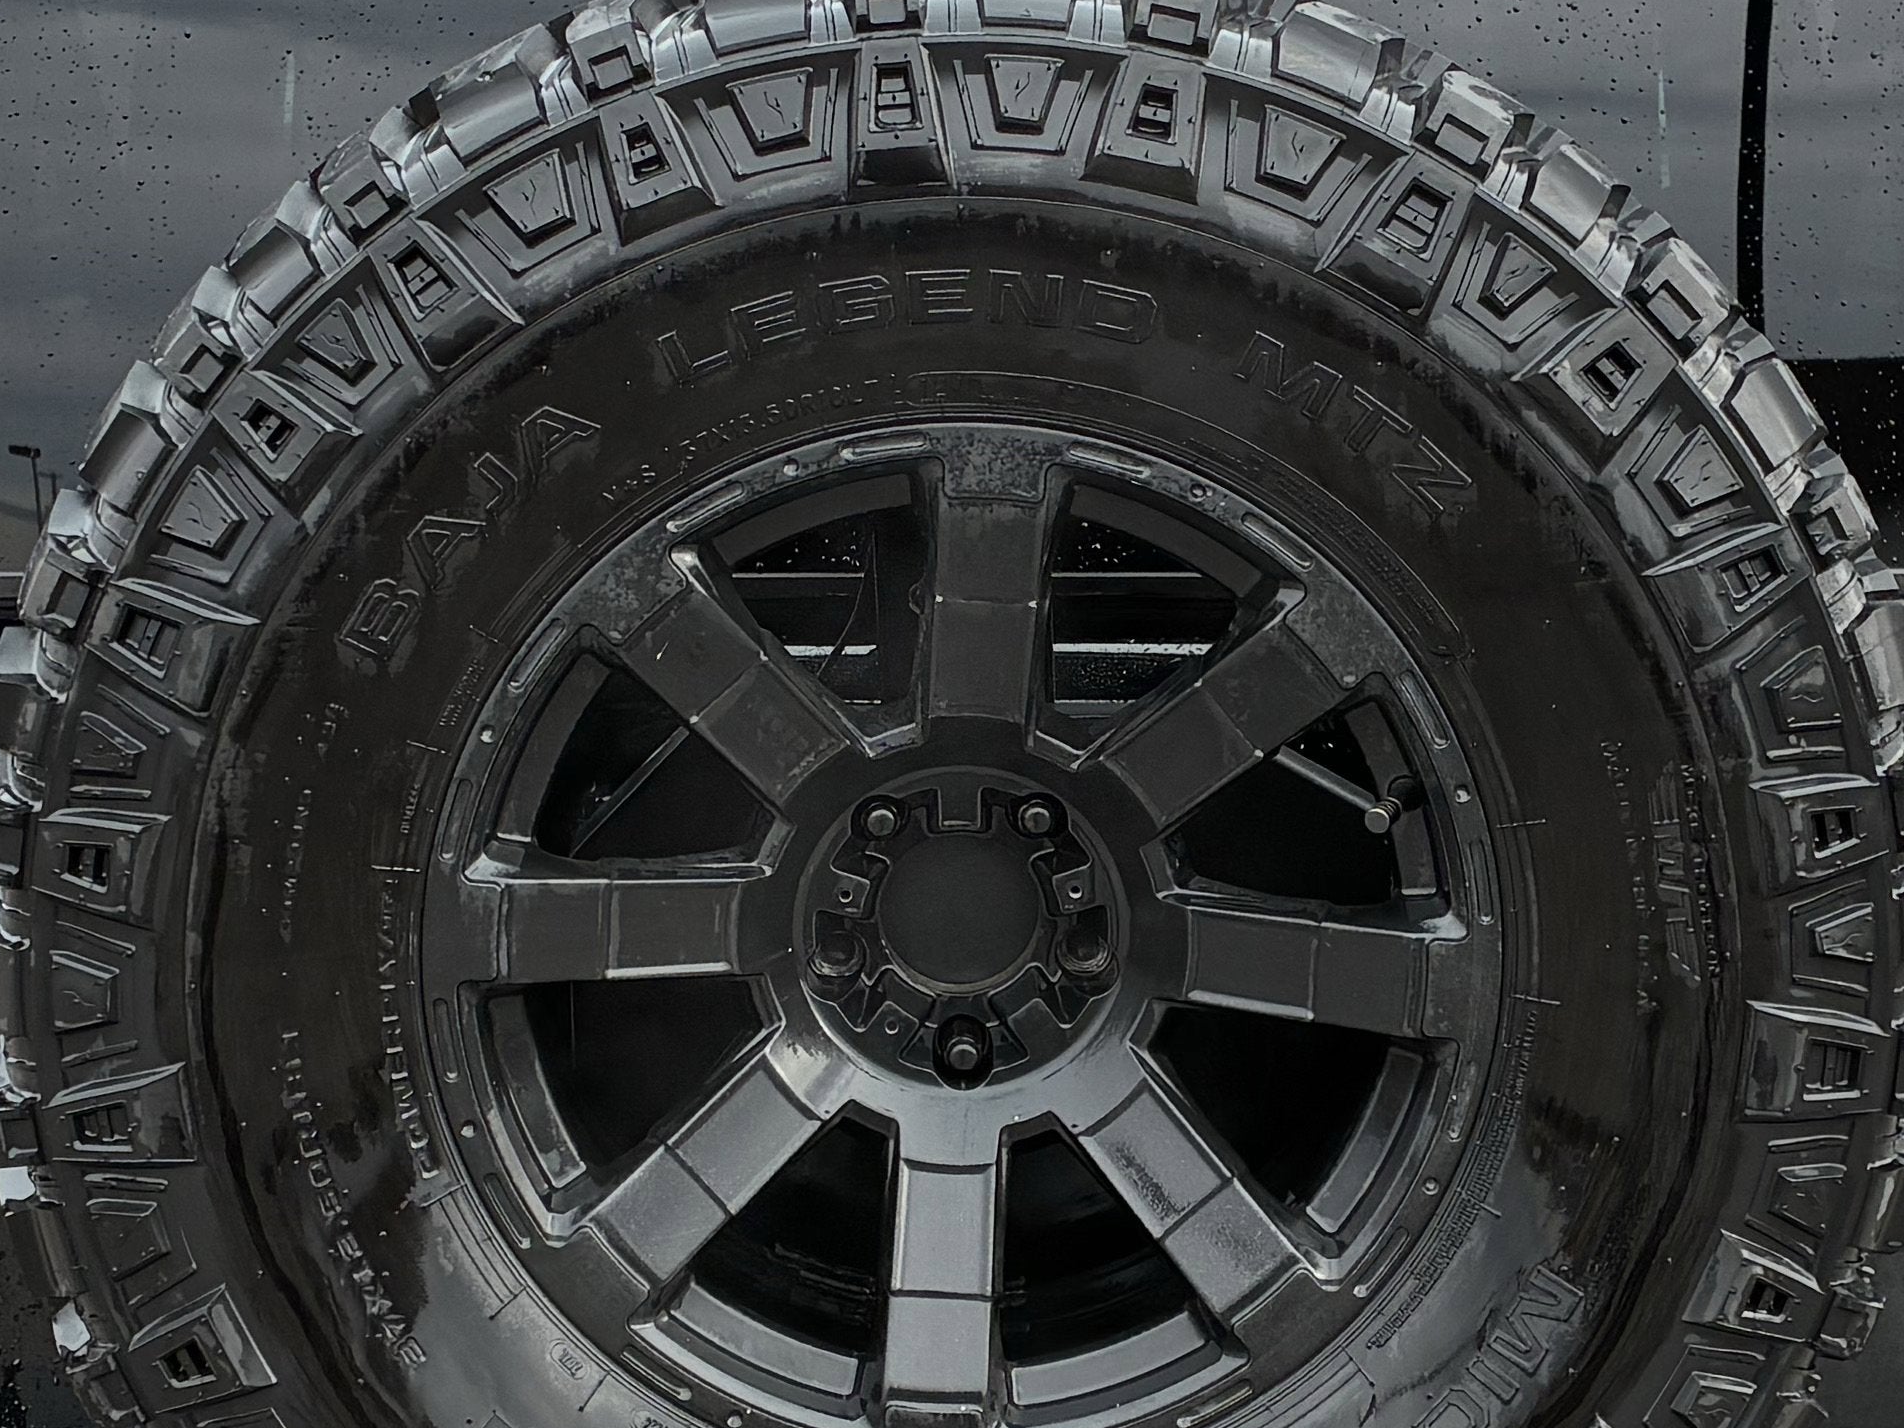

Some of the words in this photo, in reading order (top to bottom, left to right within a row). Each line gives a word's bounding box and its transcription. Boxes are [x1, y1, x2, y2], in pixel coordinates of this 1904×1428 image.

[339, 404, 603, 666] BAJA
[655, 267, 1158, 391] LEGEND
[1232, 330, 1474, 512] MTZ
